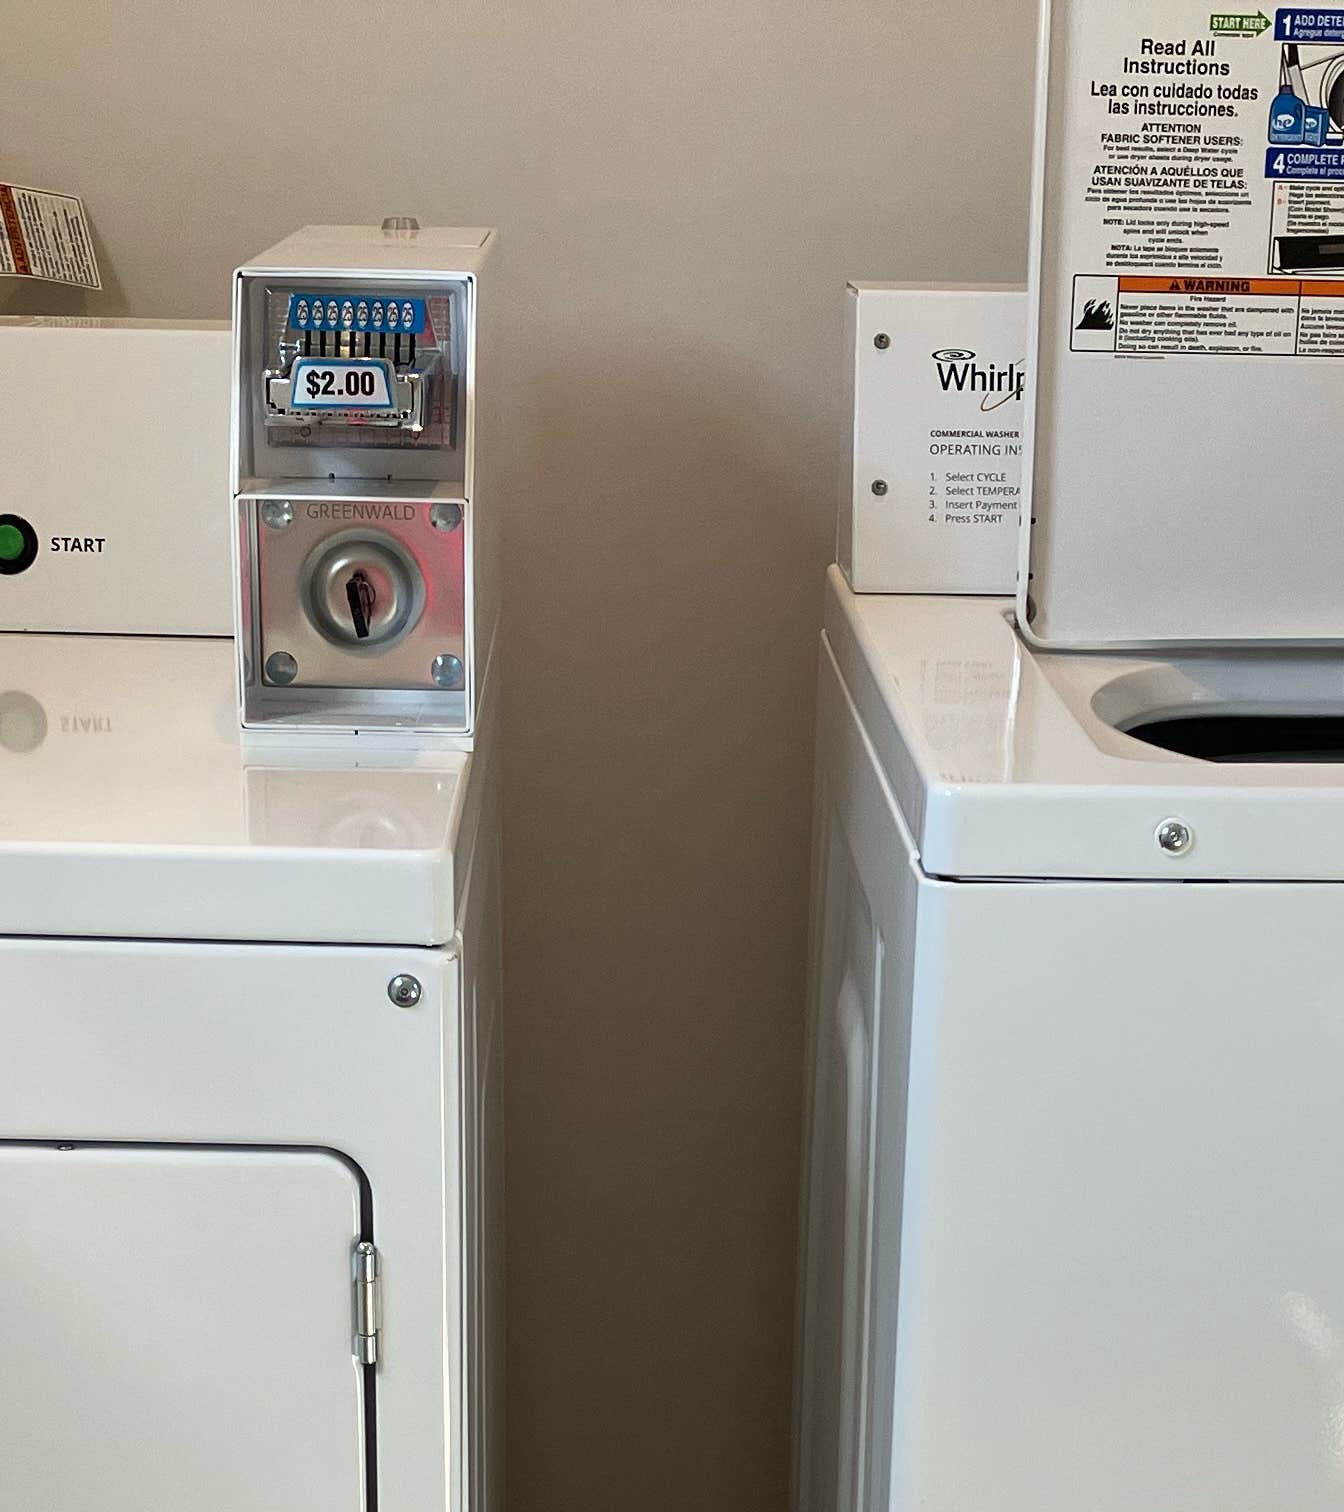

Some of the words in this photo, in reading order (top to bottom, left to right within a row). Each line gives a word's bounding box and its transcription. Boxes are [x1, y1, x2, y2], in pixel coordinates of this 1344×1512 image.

[1212, 17, 1241, 29] START
[1244, 17, 1266, 29] HERE
[1283, 15, 1291, 36] 1
[1295, 16, 1315, 26] ADD
[1141, 39, 1186, 55] Read
[1192, 40, 1215, 56] All
[1124, 58, 1230, 75] Instructions
[1091, 81, 1116, 97] Lea
[1122, 85, 1148, 98] con
[1154, 83, 1212, 98] cuidado
[1218, 85, 1258, 100] todas
[1109, 99, 1129, 114] las
[1134, 100, 1238, 117] instrucciones.
[1142, 123, 1201, 133] ATTENTION
[1101, 134, 1140, 143] FABRIC
[1143, 135, 1200, 144] SOFTENER
[1204, 136, 1243, 145] USERS:
[1094, 163, 1146, 175] ATENCIÓN
[1150, 167, 1157, 175] A
[1161, 166, 1218, 177] AQUÉLLOS
[1221, 168, 1243, 177] QUE
[1273, 154, 1285, 174] 4
[1288, 154, 1339, 165] COMPLETE
[1286, 166, 1318, 176] Complete
[1092, 177, 1120, 186] USAN
[1125, 178, 1190, 187] SUAVIZANTE
[1194, 179, 1207, 188] DE
[1210, 180, 1247, 189] TELAS:
[1184, 280, 1250, 292] WARNING
[306, 370, 375, 399] $2.00
[930, 445, 1001, 455] OPERATING
[931, 473, 937, 481] 1.
[945, 473, 974, 482] Select
[976, 473, 1006, 482] CYCLE
[930, 487, 937, 495] 2.
[945, 487, 974, 496] Select
[307, 505, 415, 520] GREENWALD
[929, 501, 937, 509] 3.
[945, 501, 973, 509] Insert
[976, 501, 1017, 512] Payment
[945, 515, 970, 523] Press
[973, 515, 1002, 523] START
[51, 538, 105, 553] START
